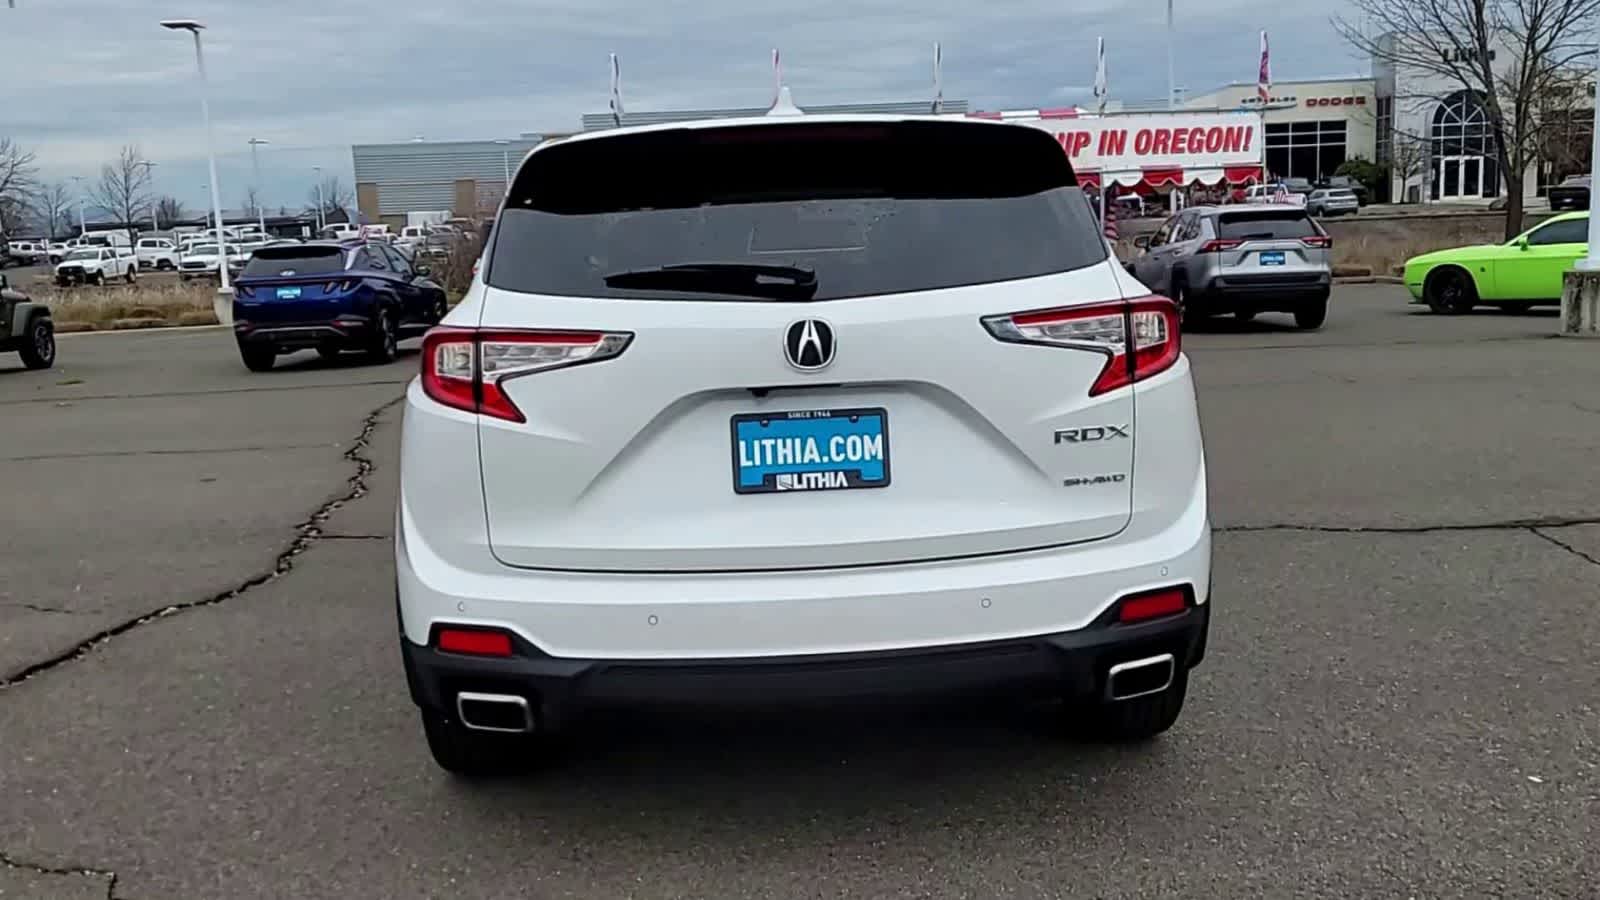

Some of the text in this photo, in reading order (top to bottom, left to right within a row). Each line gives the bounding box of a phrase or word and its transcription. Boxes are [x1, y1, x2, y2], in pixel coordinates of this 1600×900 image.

[1306, 96, 1366, 107] DODGE
[1097, 129, 1128, 156] IN
[1134, 126, 1254, 156] OREGON!
[1054, 424, 1128, 444] RDX
[739, 433, 883, 467] LITHIA.COM
[793, 471, 848, 490] LITHIA
